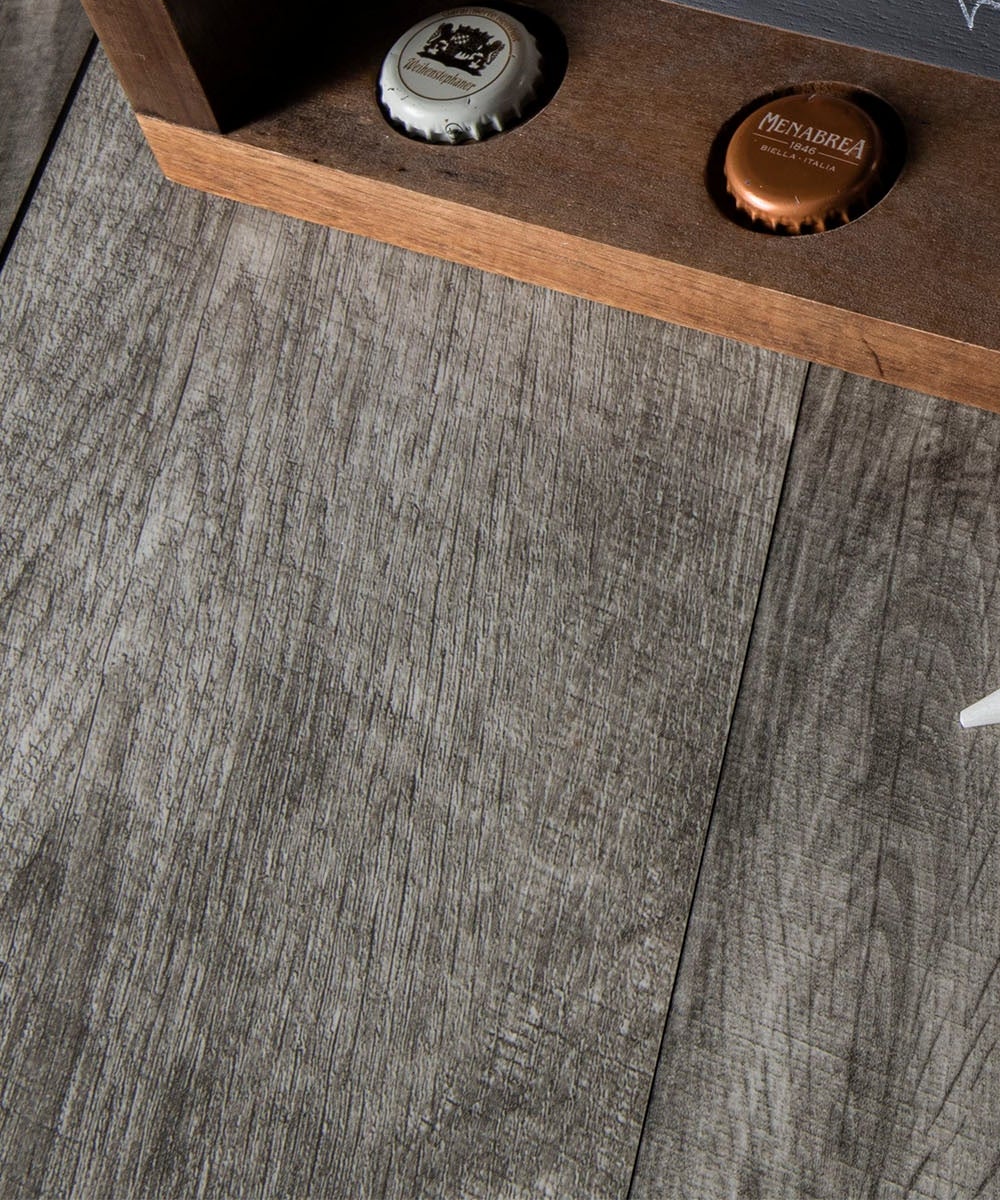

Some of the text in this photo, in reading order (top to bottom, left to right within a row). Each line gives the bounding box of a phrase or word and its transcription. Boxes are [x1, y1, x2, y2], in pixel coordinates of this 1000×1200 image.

[402, 57, 477, 92] Weihenstephaner
[758, 112, 866, 160] MENABREA
[789, 141, 816, 156] 1846
[760, 144, 836, 172] BIELLA ITALIA
